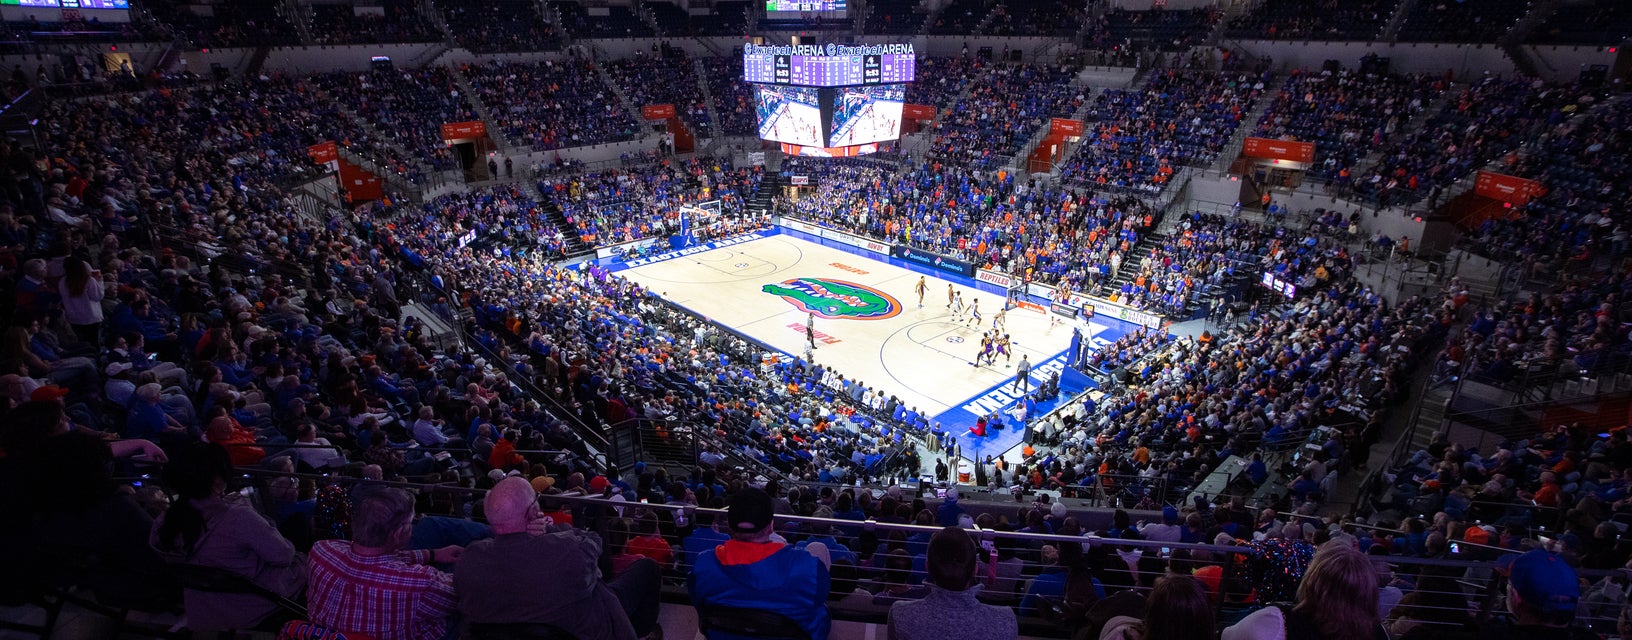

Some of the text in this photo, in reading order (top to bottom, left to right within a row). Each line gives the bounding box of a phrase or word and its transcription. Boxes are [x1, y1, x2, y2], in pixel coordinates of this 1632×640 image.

[752, 43, 824, 56] Exactech ARENA
[836, 43, 914, 55] Exactech ARENA
[626, 244, 711, 268] EXACTECH
[714, 233, 763, 248] ARENA
[909, 253, 930, 263] Domino's
[941, 261, 963, 272] Domino's
[980, 272, 1009, 286] REPTILES
